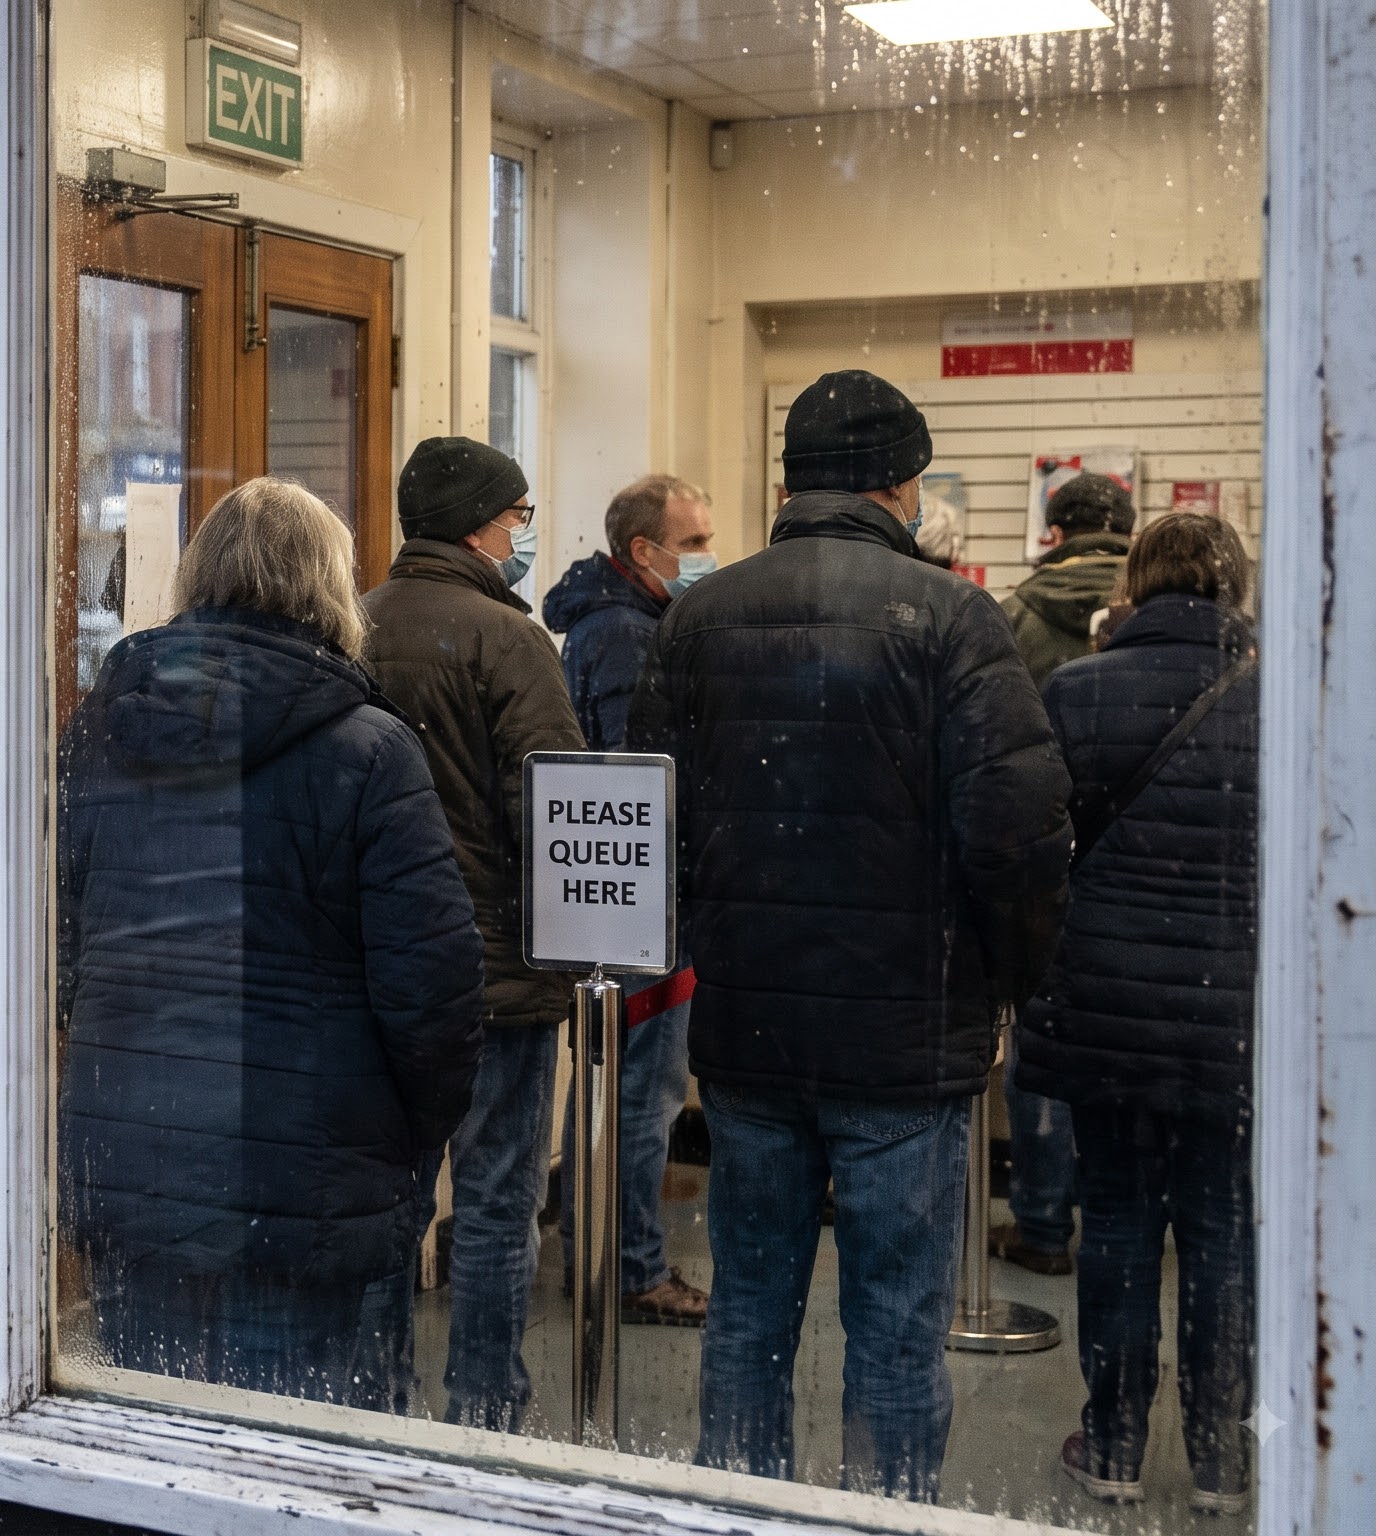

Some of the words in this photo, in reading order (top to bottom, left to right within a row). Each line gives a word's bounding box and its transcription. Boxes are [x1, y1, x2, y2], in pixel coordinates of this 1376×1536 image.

[215, 64, 295, 146] EXIT
[548, 799, 651, 827] PLEASE
[548, 839, 650, 868] QUEUE
[563, 879, 637, 906] HERE
